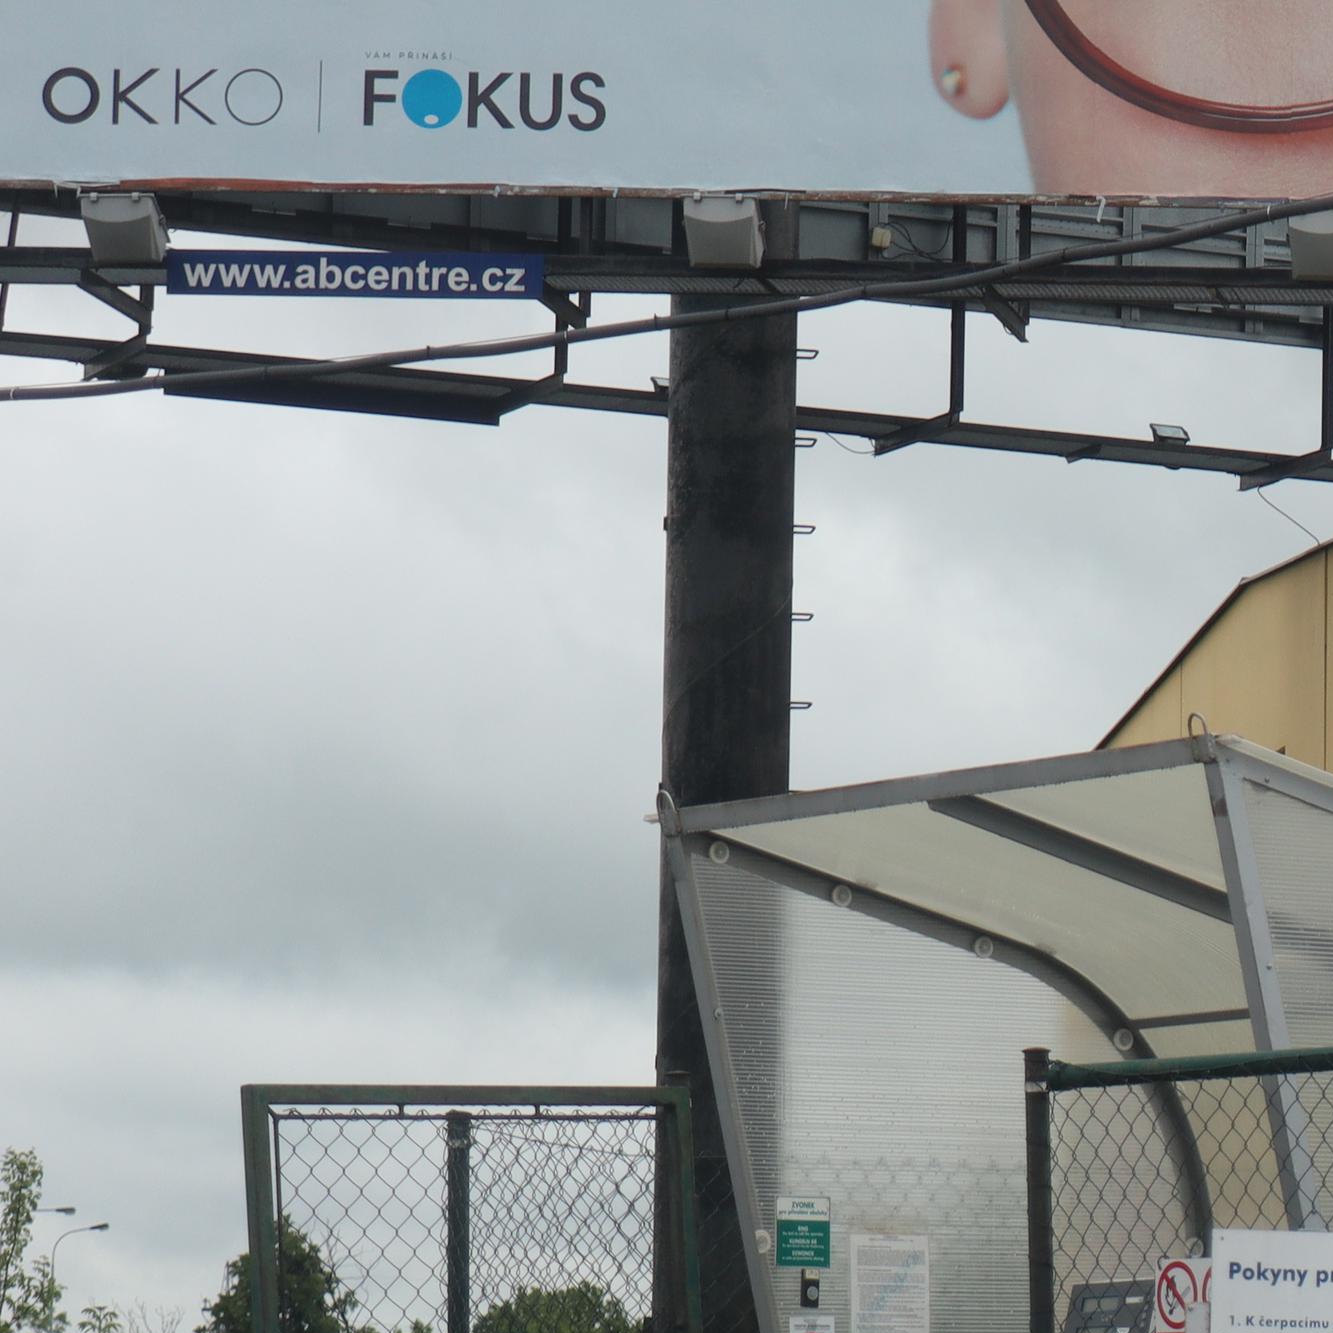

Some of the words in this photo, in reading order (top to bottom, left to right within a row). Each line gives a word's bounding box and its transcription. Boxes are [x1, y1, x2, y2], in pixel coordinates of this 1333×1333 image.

[42, 66, 283, 126] OKKO
[363, 69, 607, 132] FOKUS
[184, 257, 526, 292] www.abcentre.cz
[1229, 1262, 1308, 1287] Pokyny
[1229, 1315, 1241, 1326] 1.
[1245, 1316, 1255, 1326] K
[1258, 1316, 1329, 1330] čerpacímu
